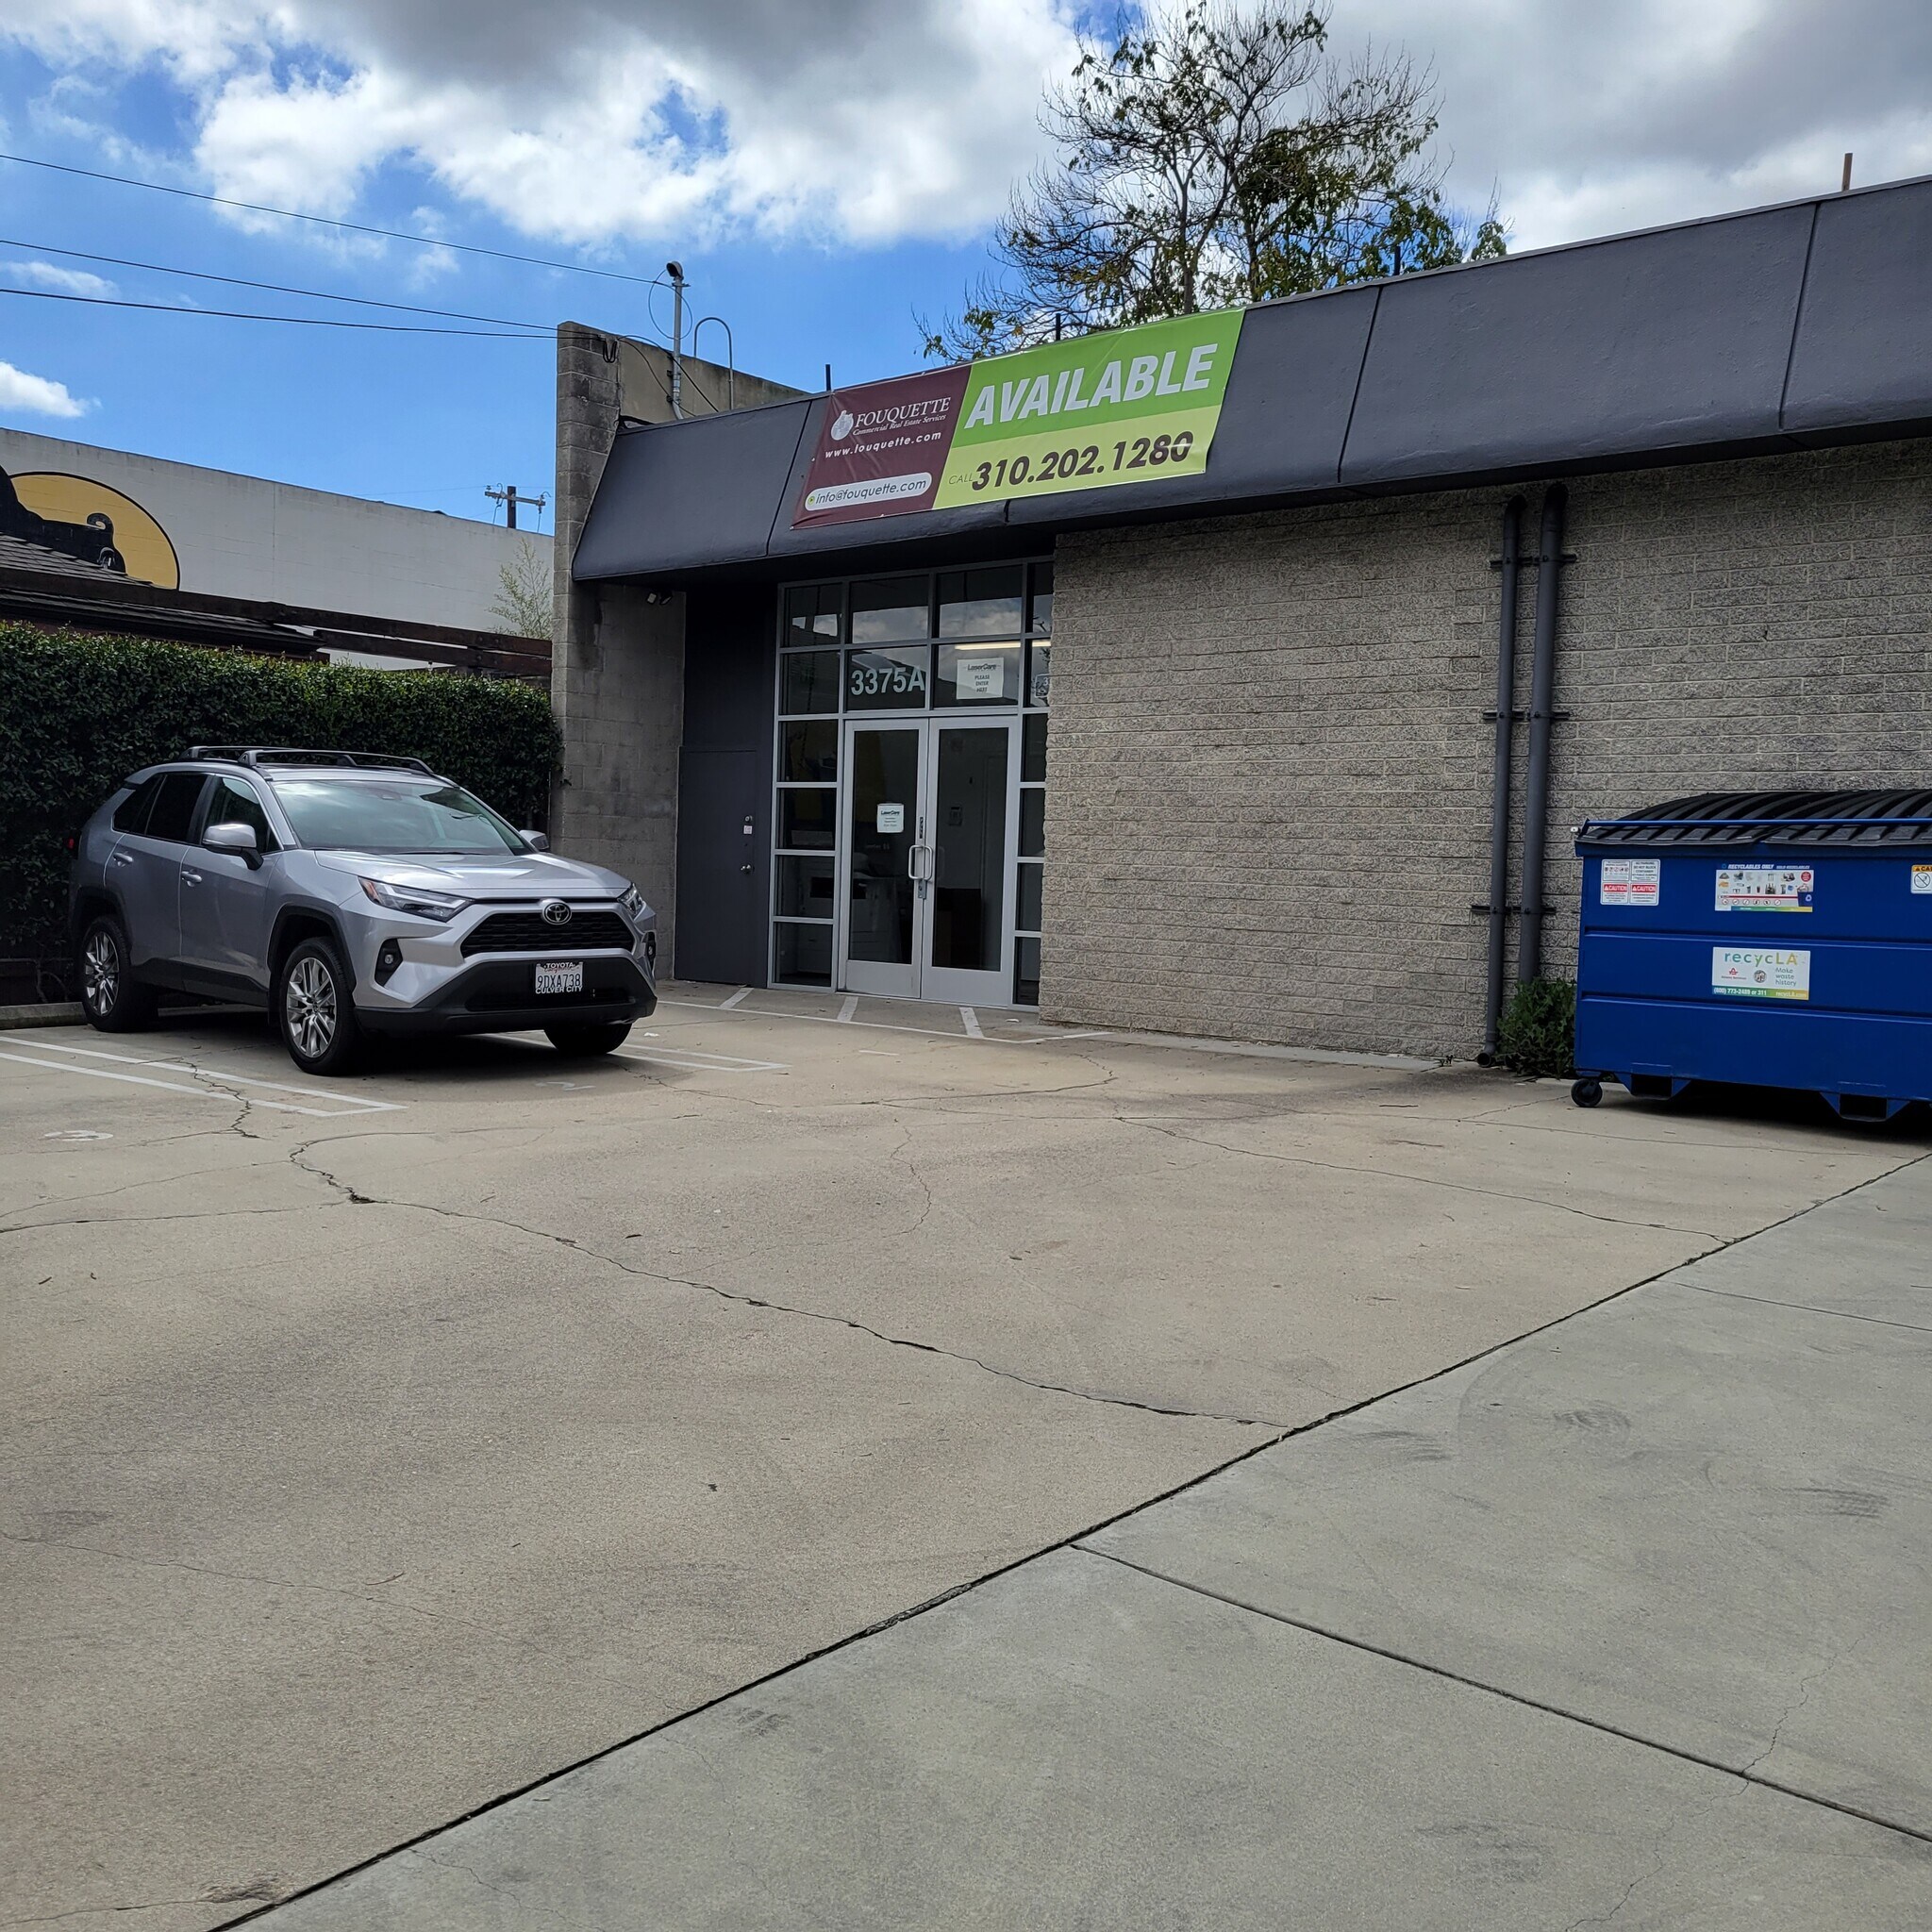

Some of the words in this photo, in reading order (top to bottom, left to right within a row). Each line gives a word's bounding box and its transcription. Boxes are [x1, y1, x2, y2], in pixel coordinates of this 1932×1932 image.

[964, 343, 1218, 429] AVAILABLE
[853, 425, 888, 436] Commercial
[890, 422, 902, 430] Real
[904, 419, 921, 427] Estate
[923, 414, 946, 424] Services
[855, 397, 951, 427] FOUQUETTE
[948, 473, 973, 485] CALL
[972, 431, 1193, 491] 310.202.1280
[816, 479, 926, 504] info@fouquette.com
[851, 665, 925, 695] 3375A
[1724, 952, 1798, 967] recycLA
[538, 974, 581, 988] 9DXA738
